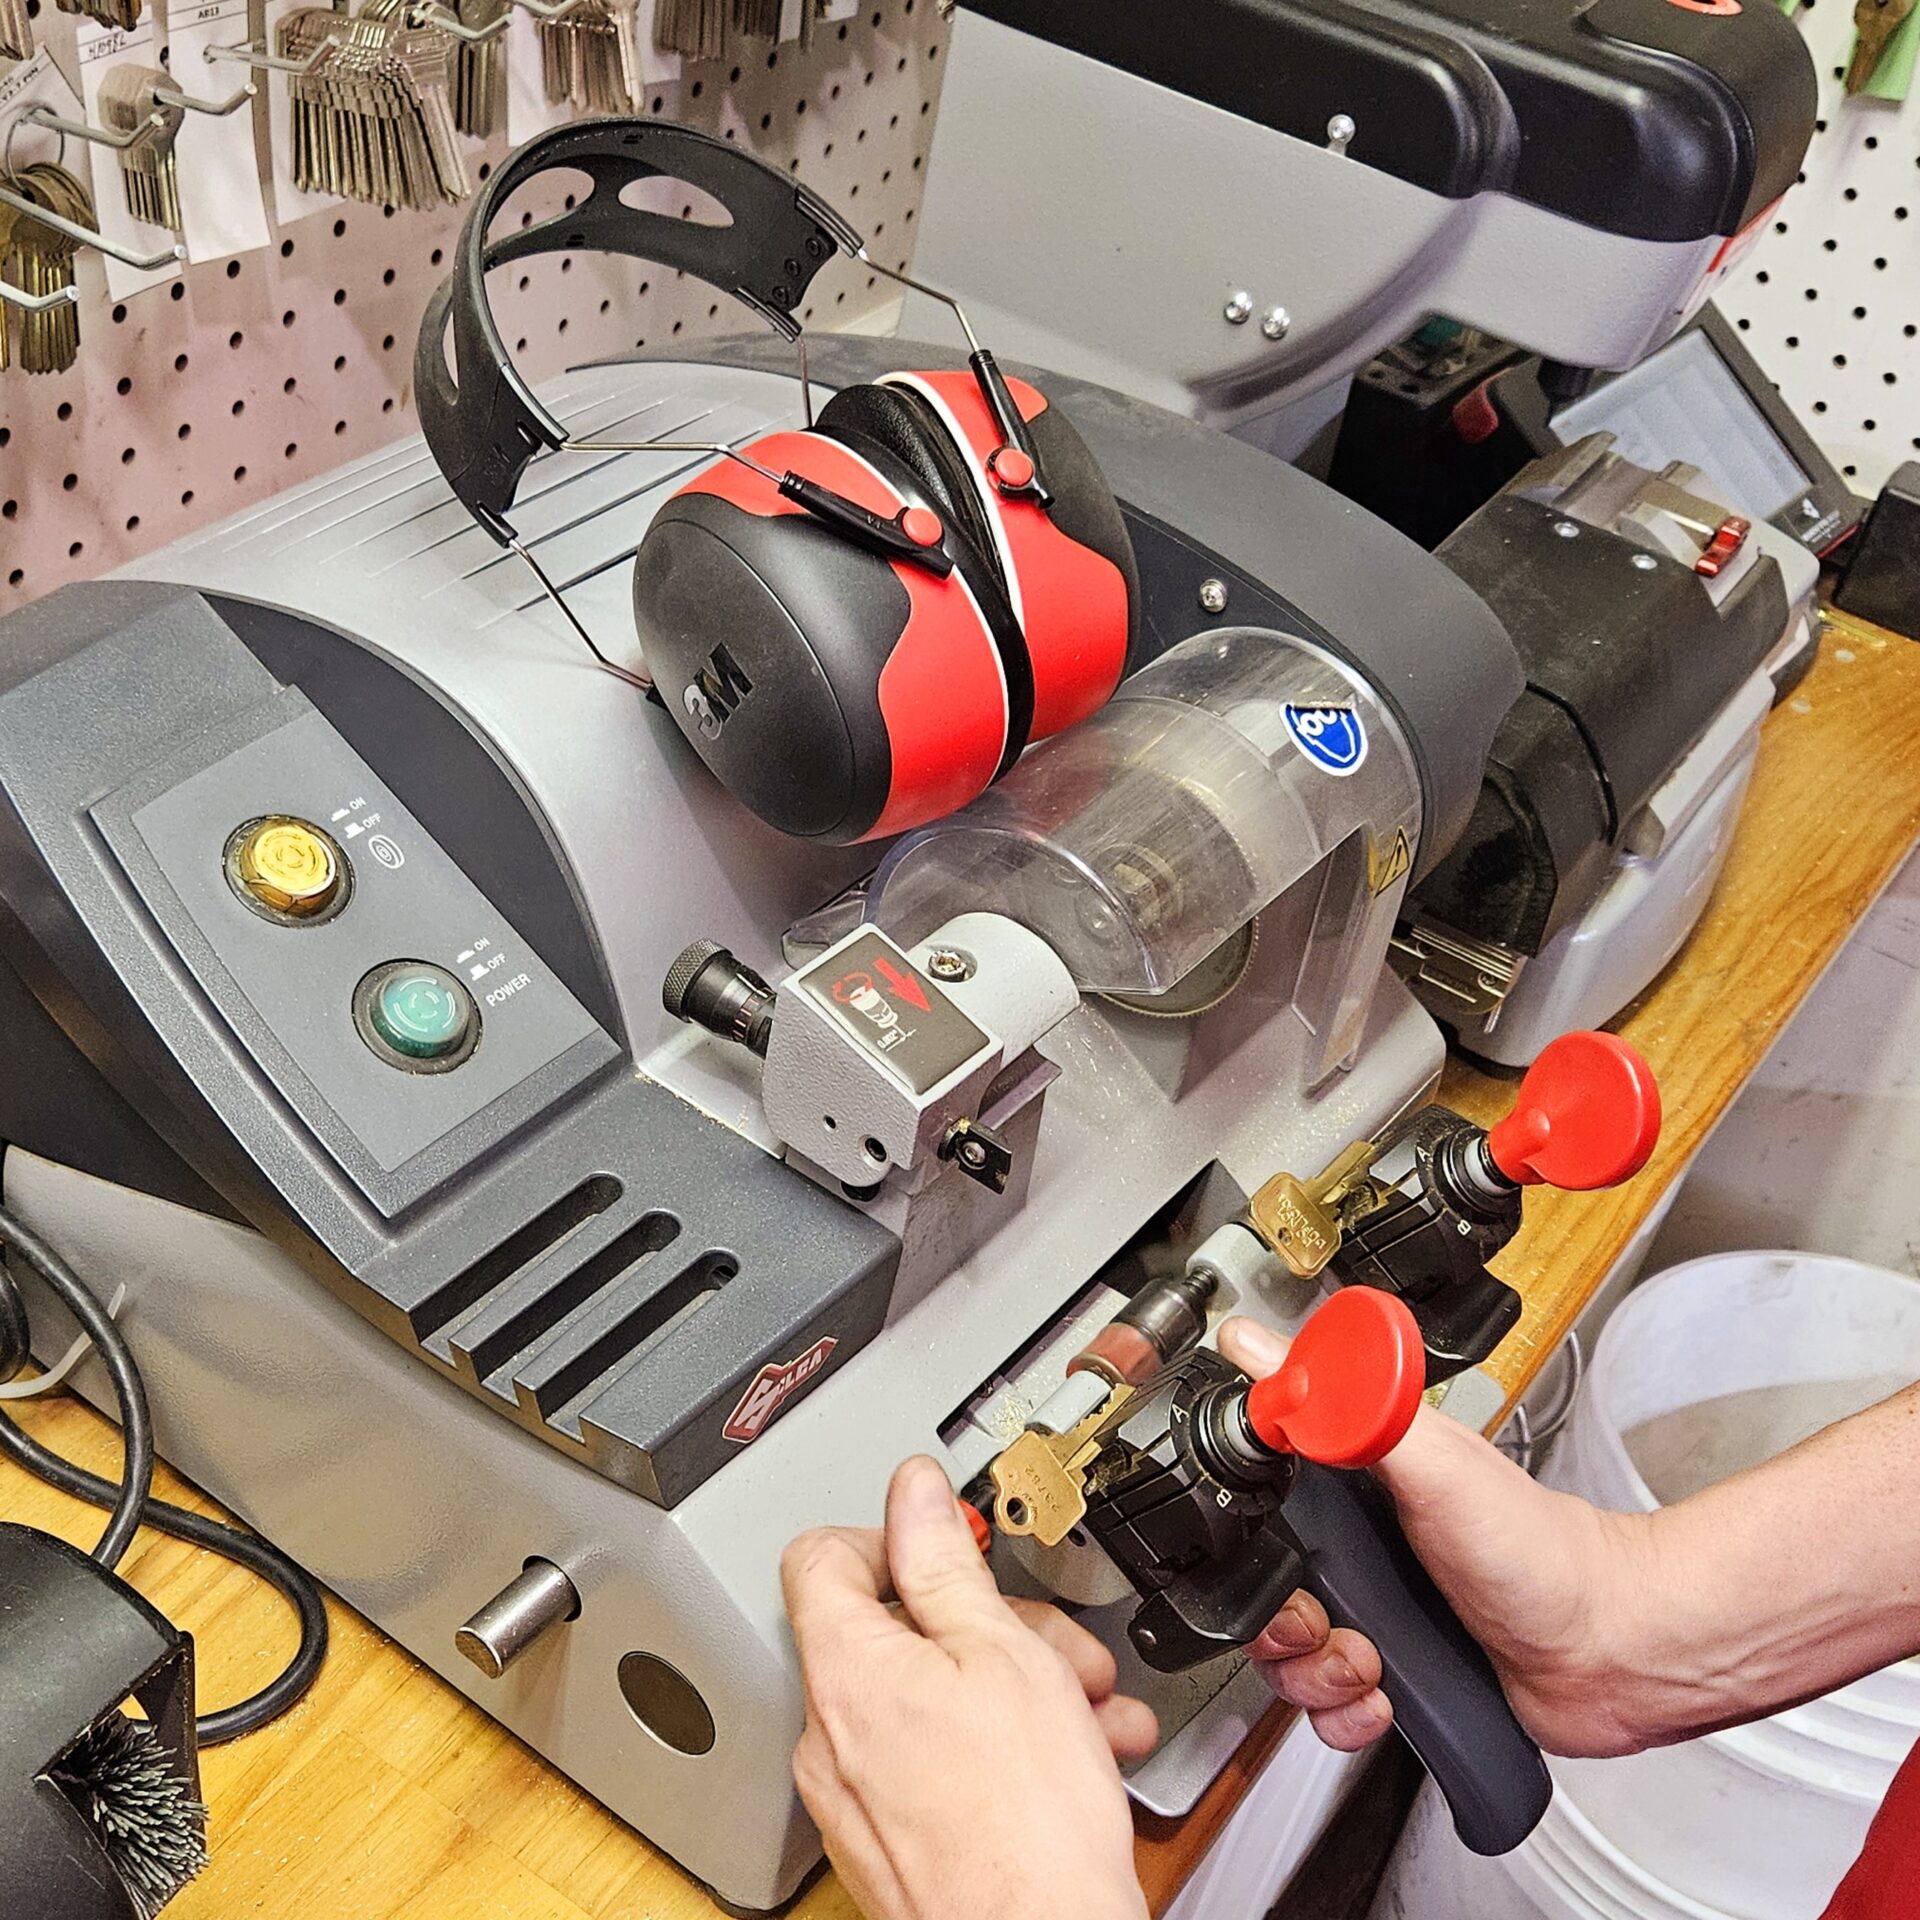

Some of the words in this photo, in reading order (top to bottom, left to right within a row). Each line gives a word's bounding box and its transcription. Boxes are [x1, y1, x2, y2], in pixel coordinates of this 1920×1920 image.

[682, 641, 754, 740] 3M
[349, 796, 367, 810] ON
[362, 813, 381, 829] OFF
[473, 937, 491, 951] ON
[487, 953, 506, 970] OFF
[485, 973, 532, 1007] POWER
[1457, 1219, 1472, 1236] B
[1171, 1402, 1190, 1424] A
[1215, 1488, 1233, 1509] B
